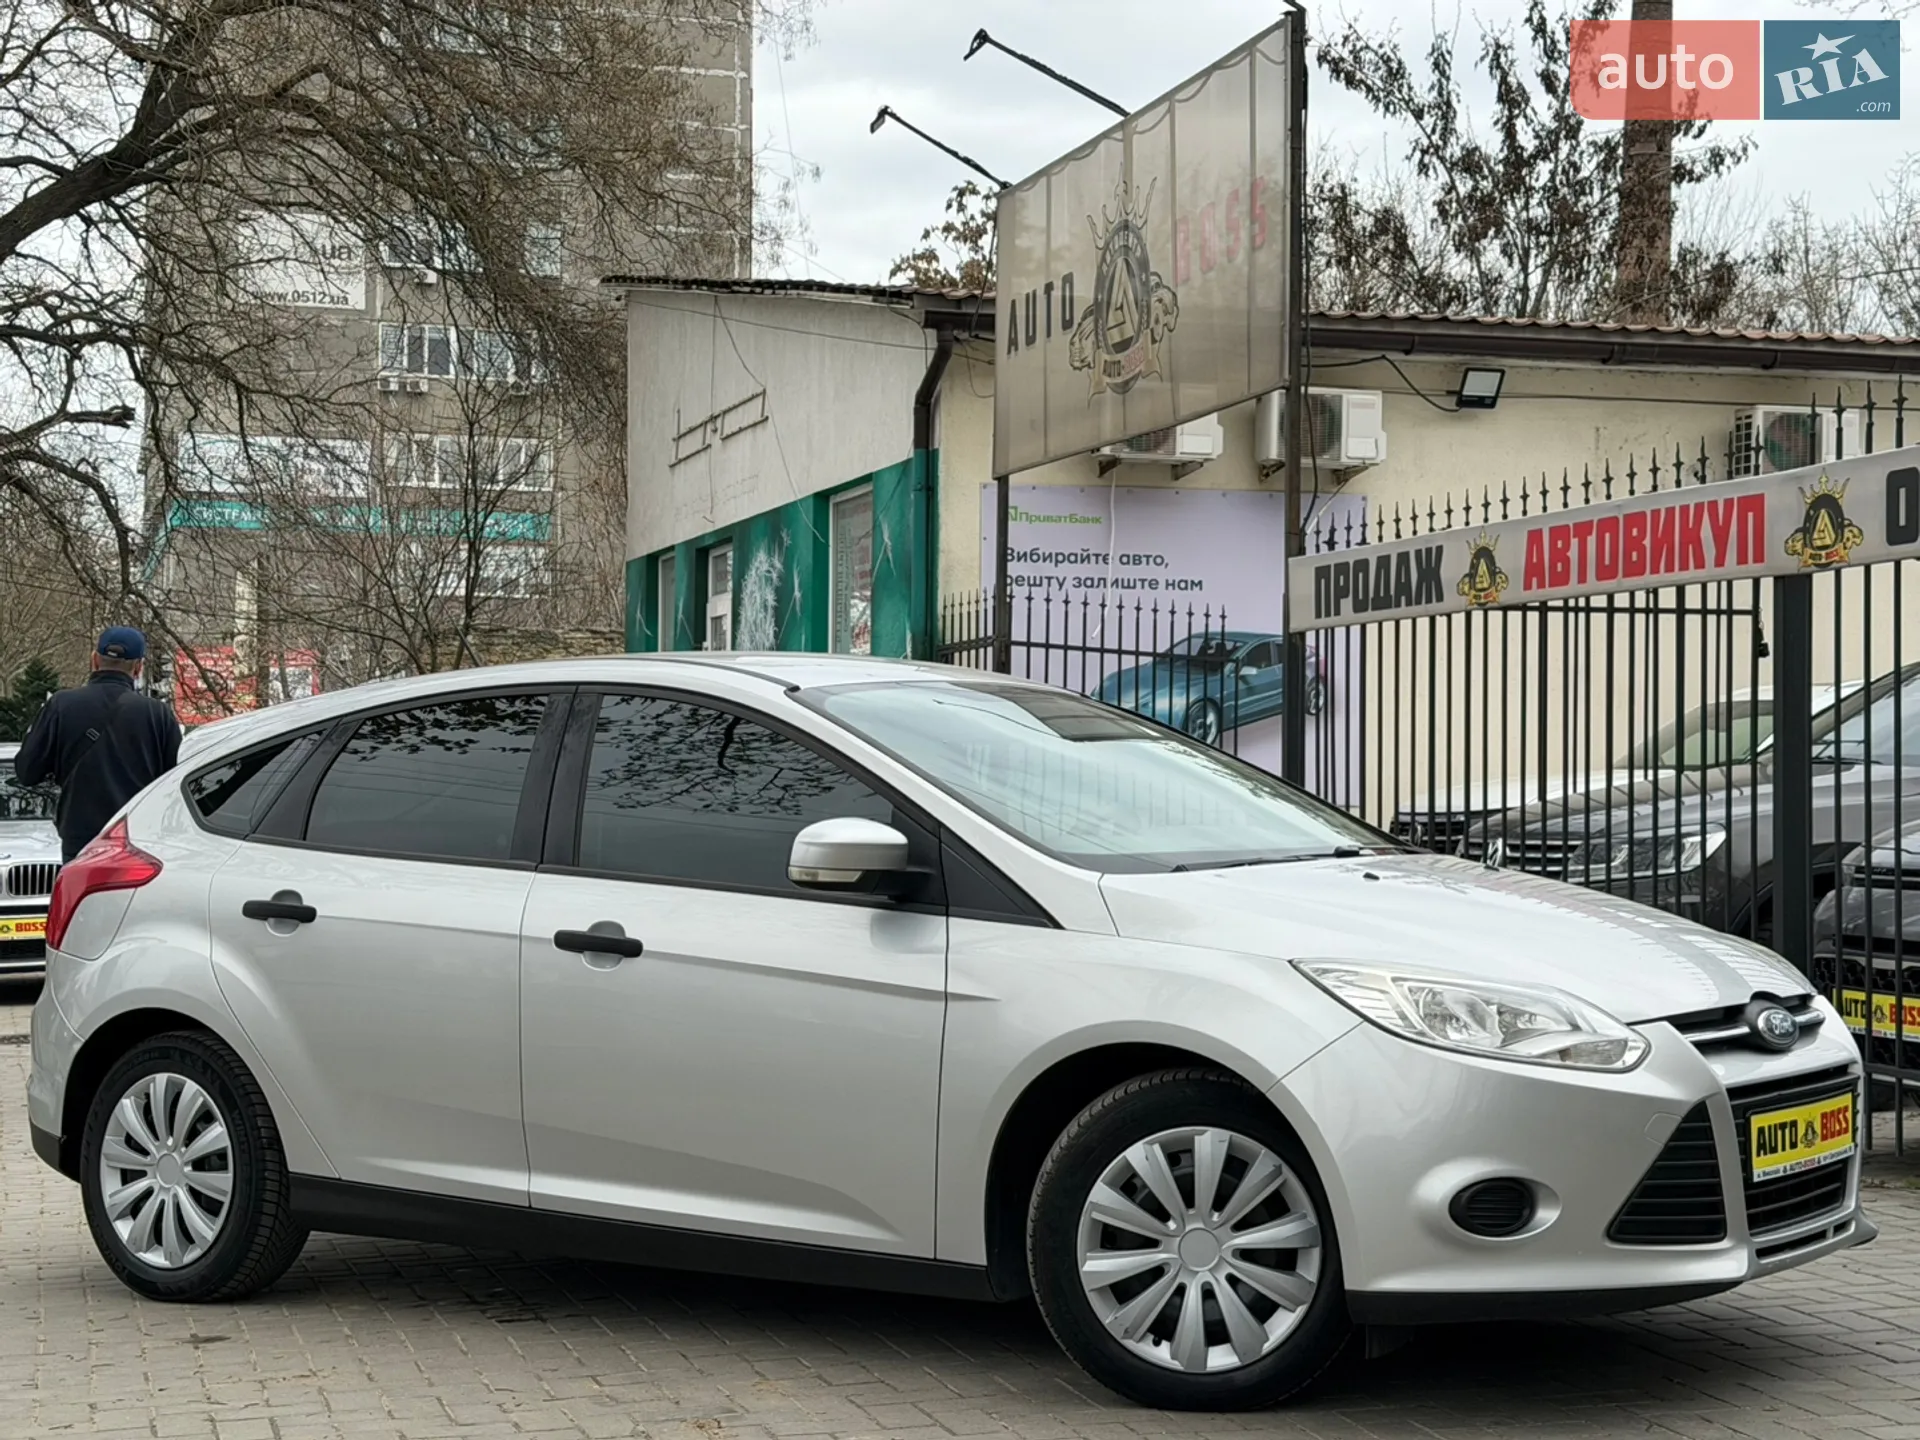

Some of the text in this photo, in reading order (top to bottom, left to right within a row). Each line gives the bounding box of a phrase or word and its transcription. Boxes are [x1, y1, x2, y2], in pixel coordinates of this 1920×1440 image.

[1006, 175, 1268, 356] AUTO BOSS
[1018, 511, 1104, 525] ПриватБанк
[1005, 547, 1170, 569] Вибирайте авто,
[1313, 492, 1766, 620] ПРОДАЖ АВТОВИКУП
[1072, 575, 1160, 592] залиште
[1165, 578, 1204, 592] нам
[15, 921, 47, 932] BOSS
[1756, 1119, 1799, 1158] AUTO
[1820, 1104, 1850, 1142] BOSS
